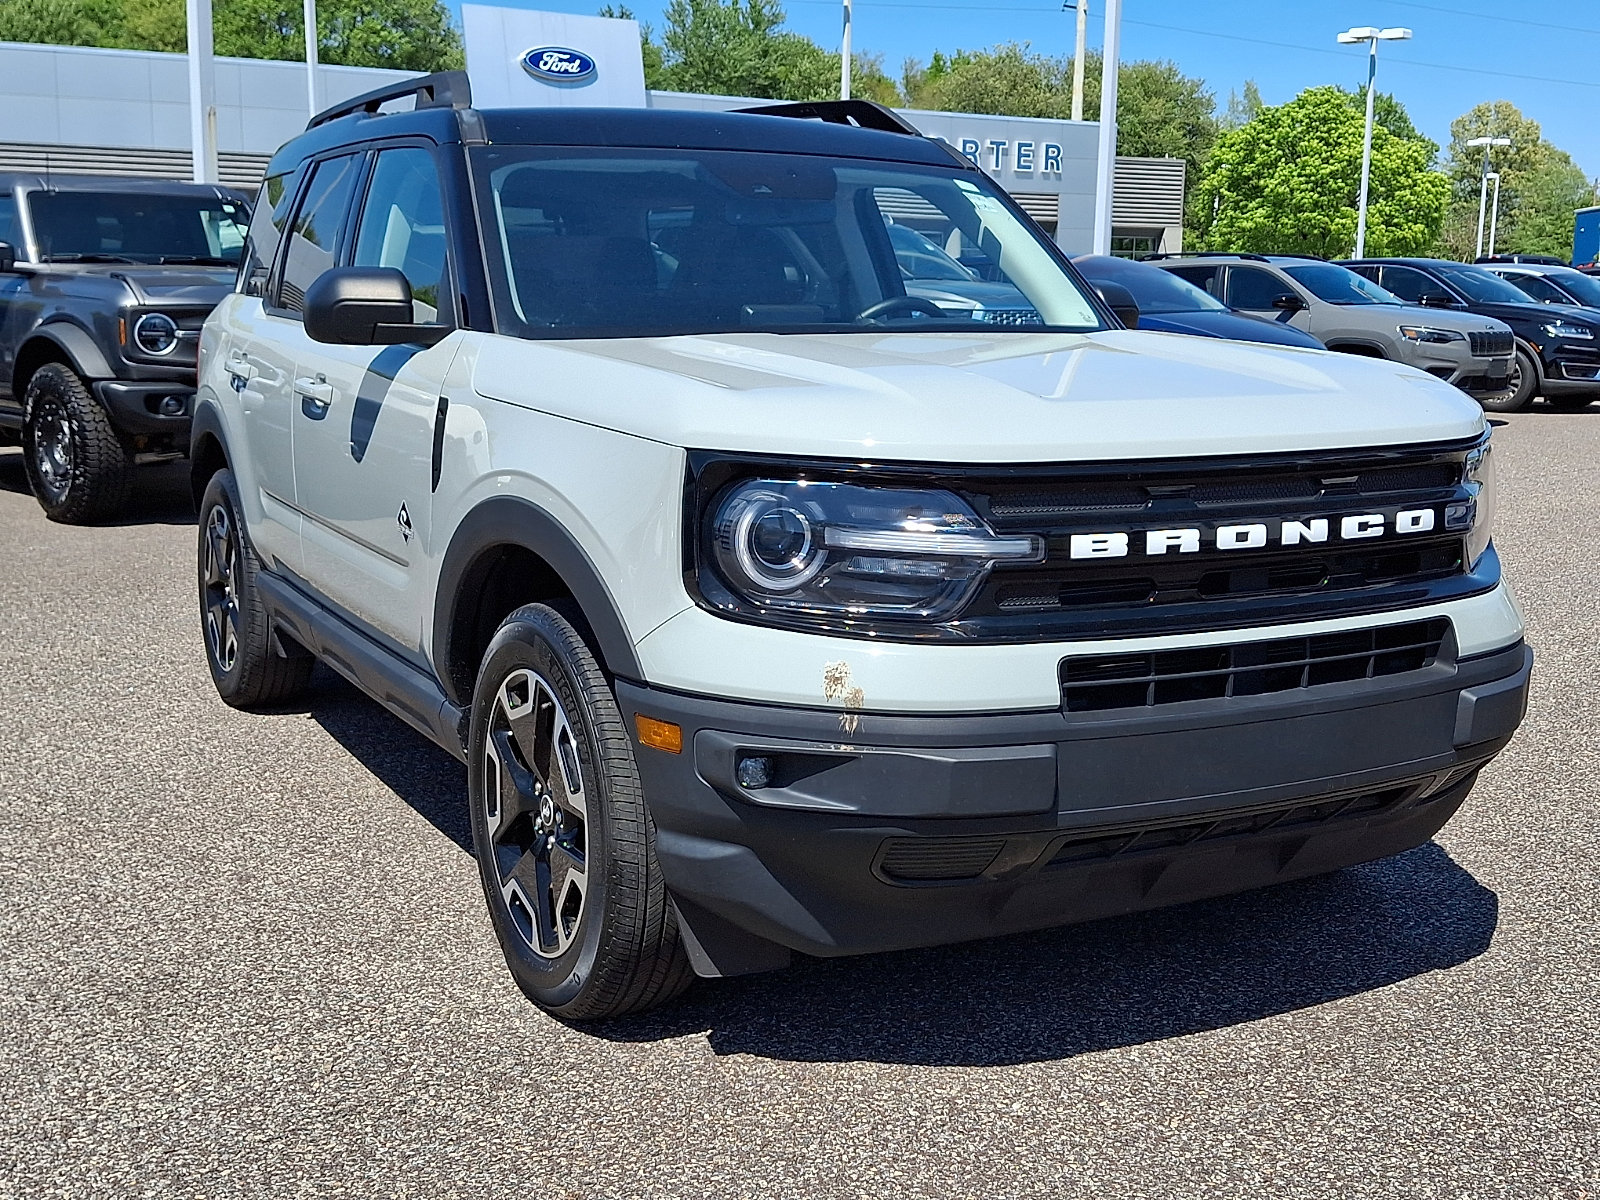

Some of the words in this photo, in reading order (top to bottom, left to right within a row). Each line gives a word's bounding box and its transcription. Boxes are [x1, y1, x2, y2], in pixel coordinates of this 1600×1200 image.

[539, 51, 580, 73] Ford
[940, 137, 1063, 173] RTER
[1070, 509, 1434, 559] BRONCO
